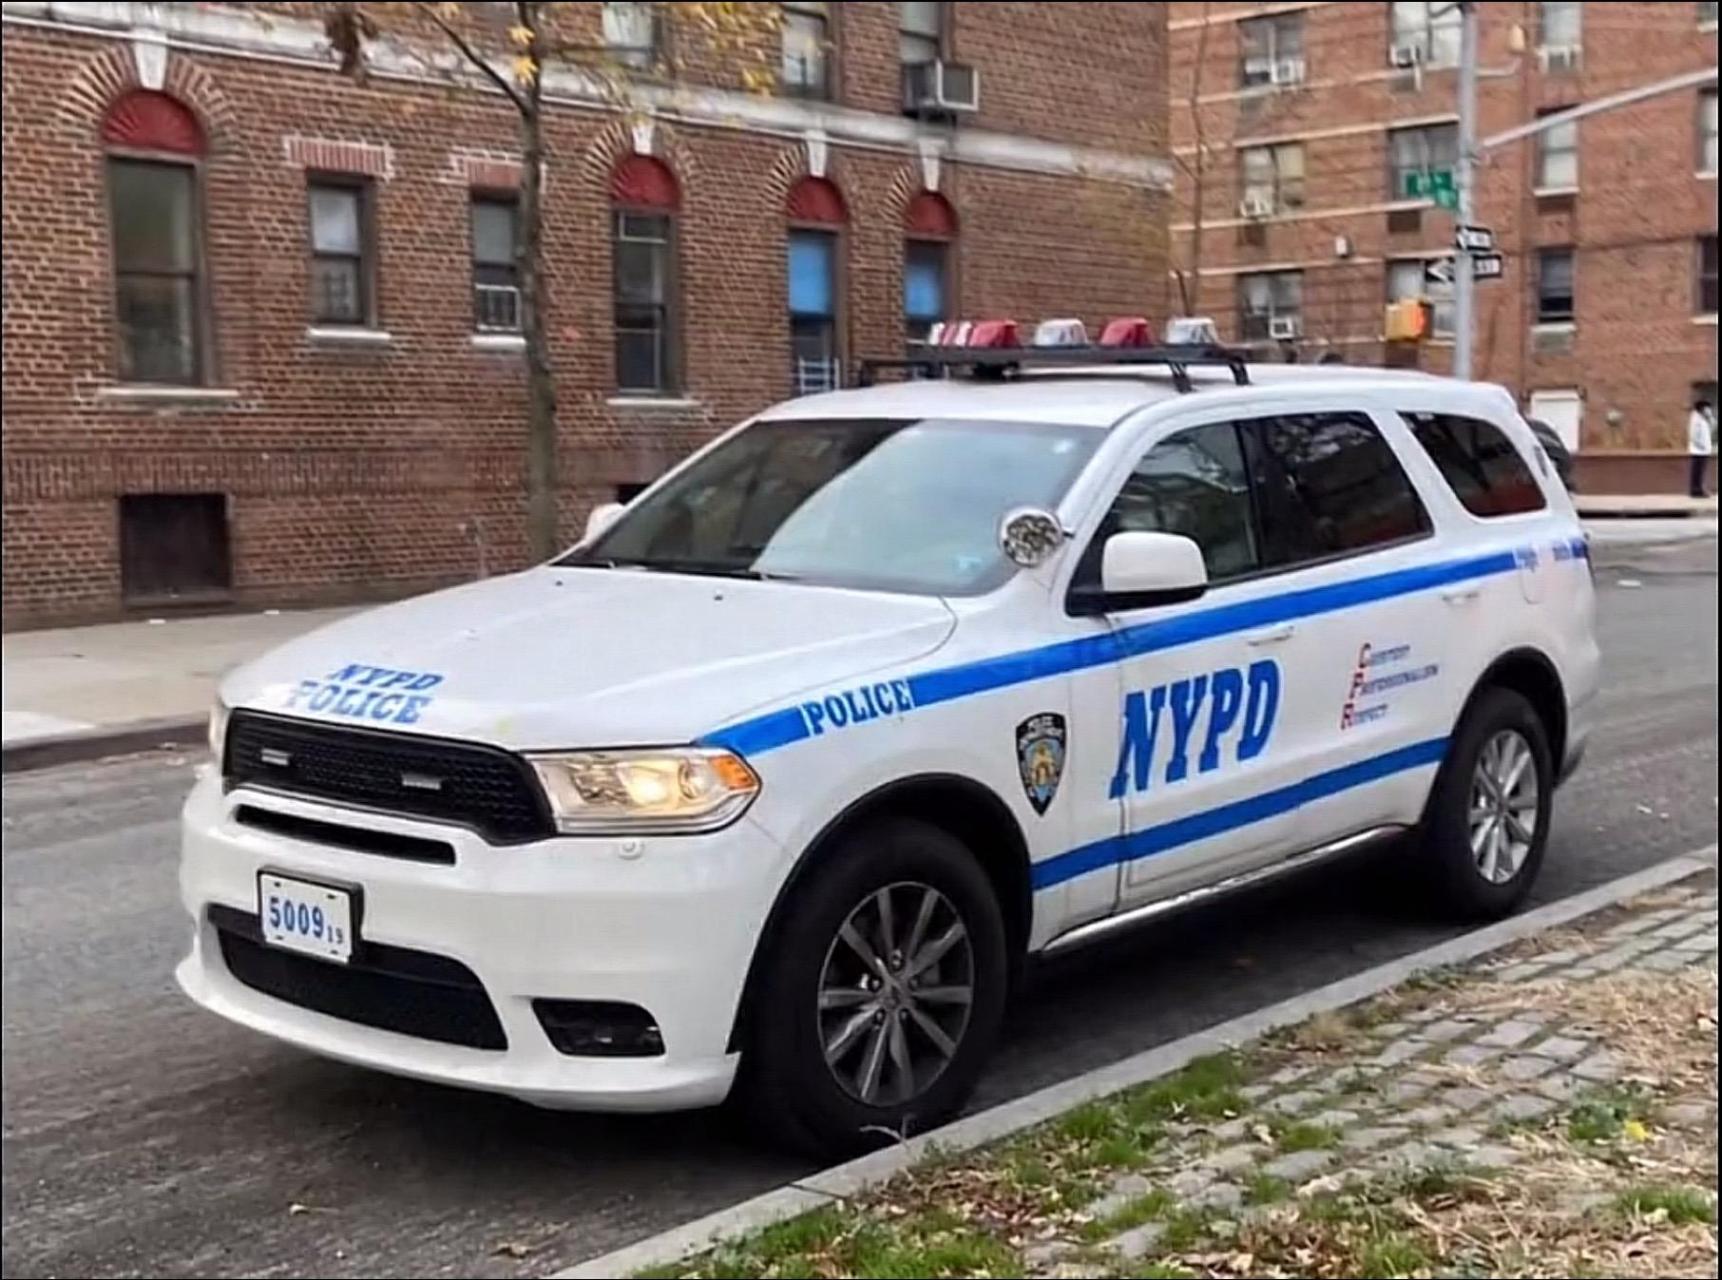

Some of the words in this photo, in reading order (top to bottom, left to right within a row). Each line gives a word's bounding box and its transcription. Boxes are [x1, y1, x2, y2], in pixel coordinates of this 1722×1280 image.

[325, 663, 444, 691] NYPD
[284, 679, 434, 724] POLICE
[801, 679, 912, 735] POLICE
[1108, 658, 1281, 801] NYPD
[269, 895, 325, 939] 5009
